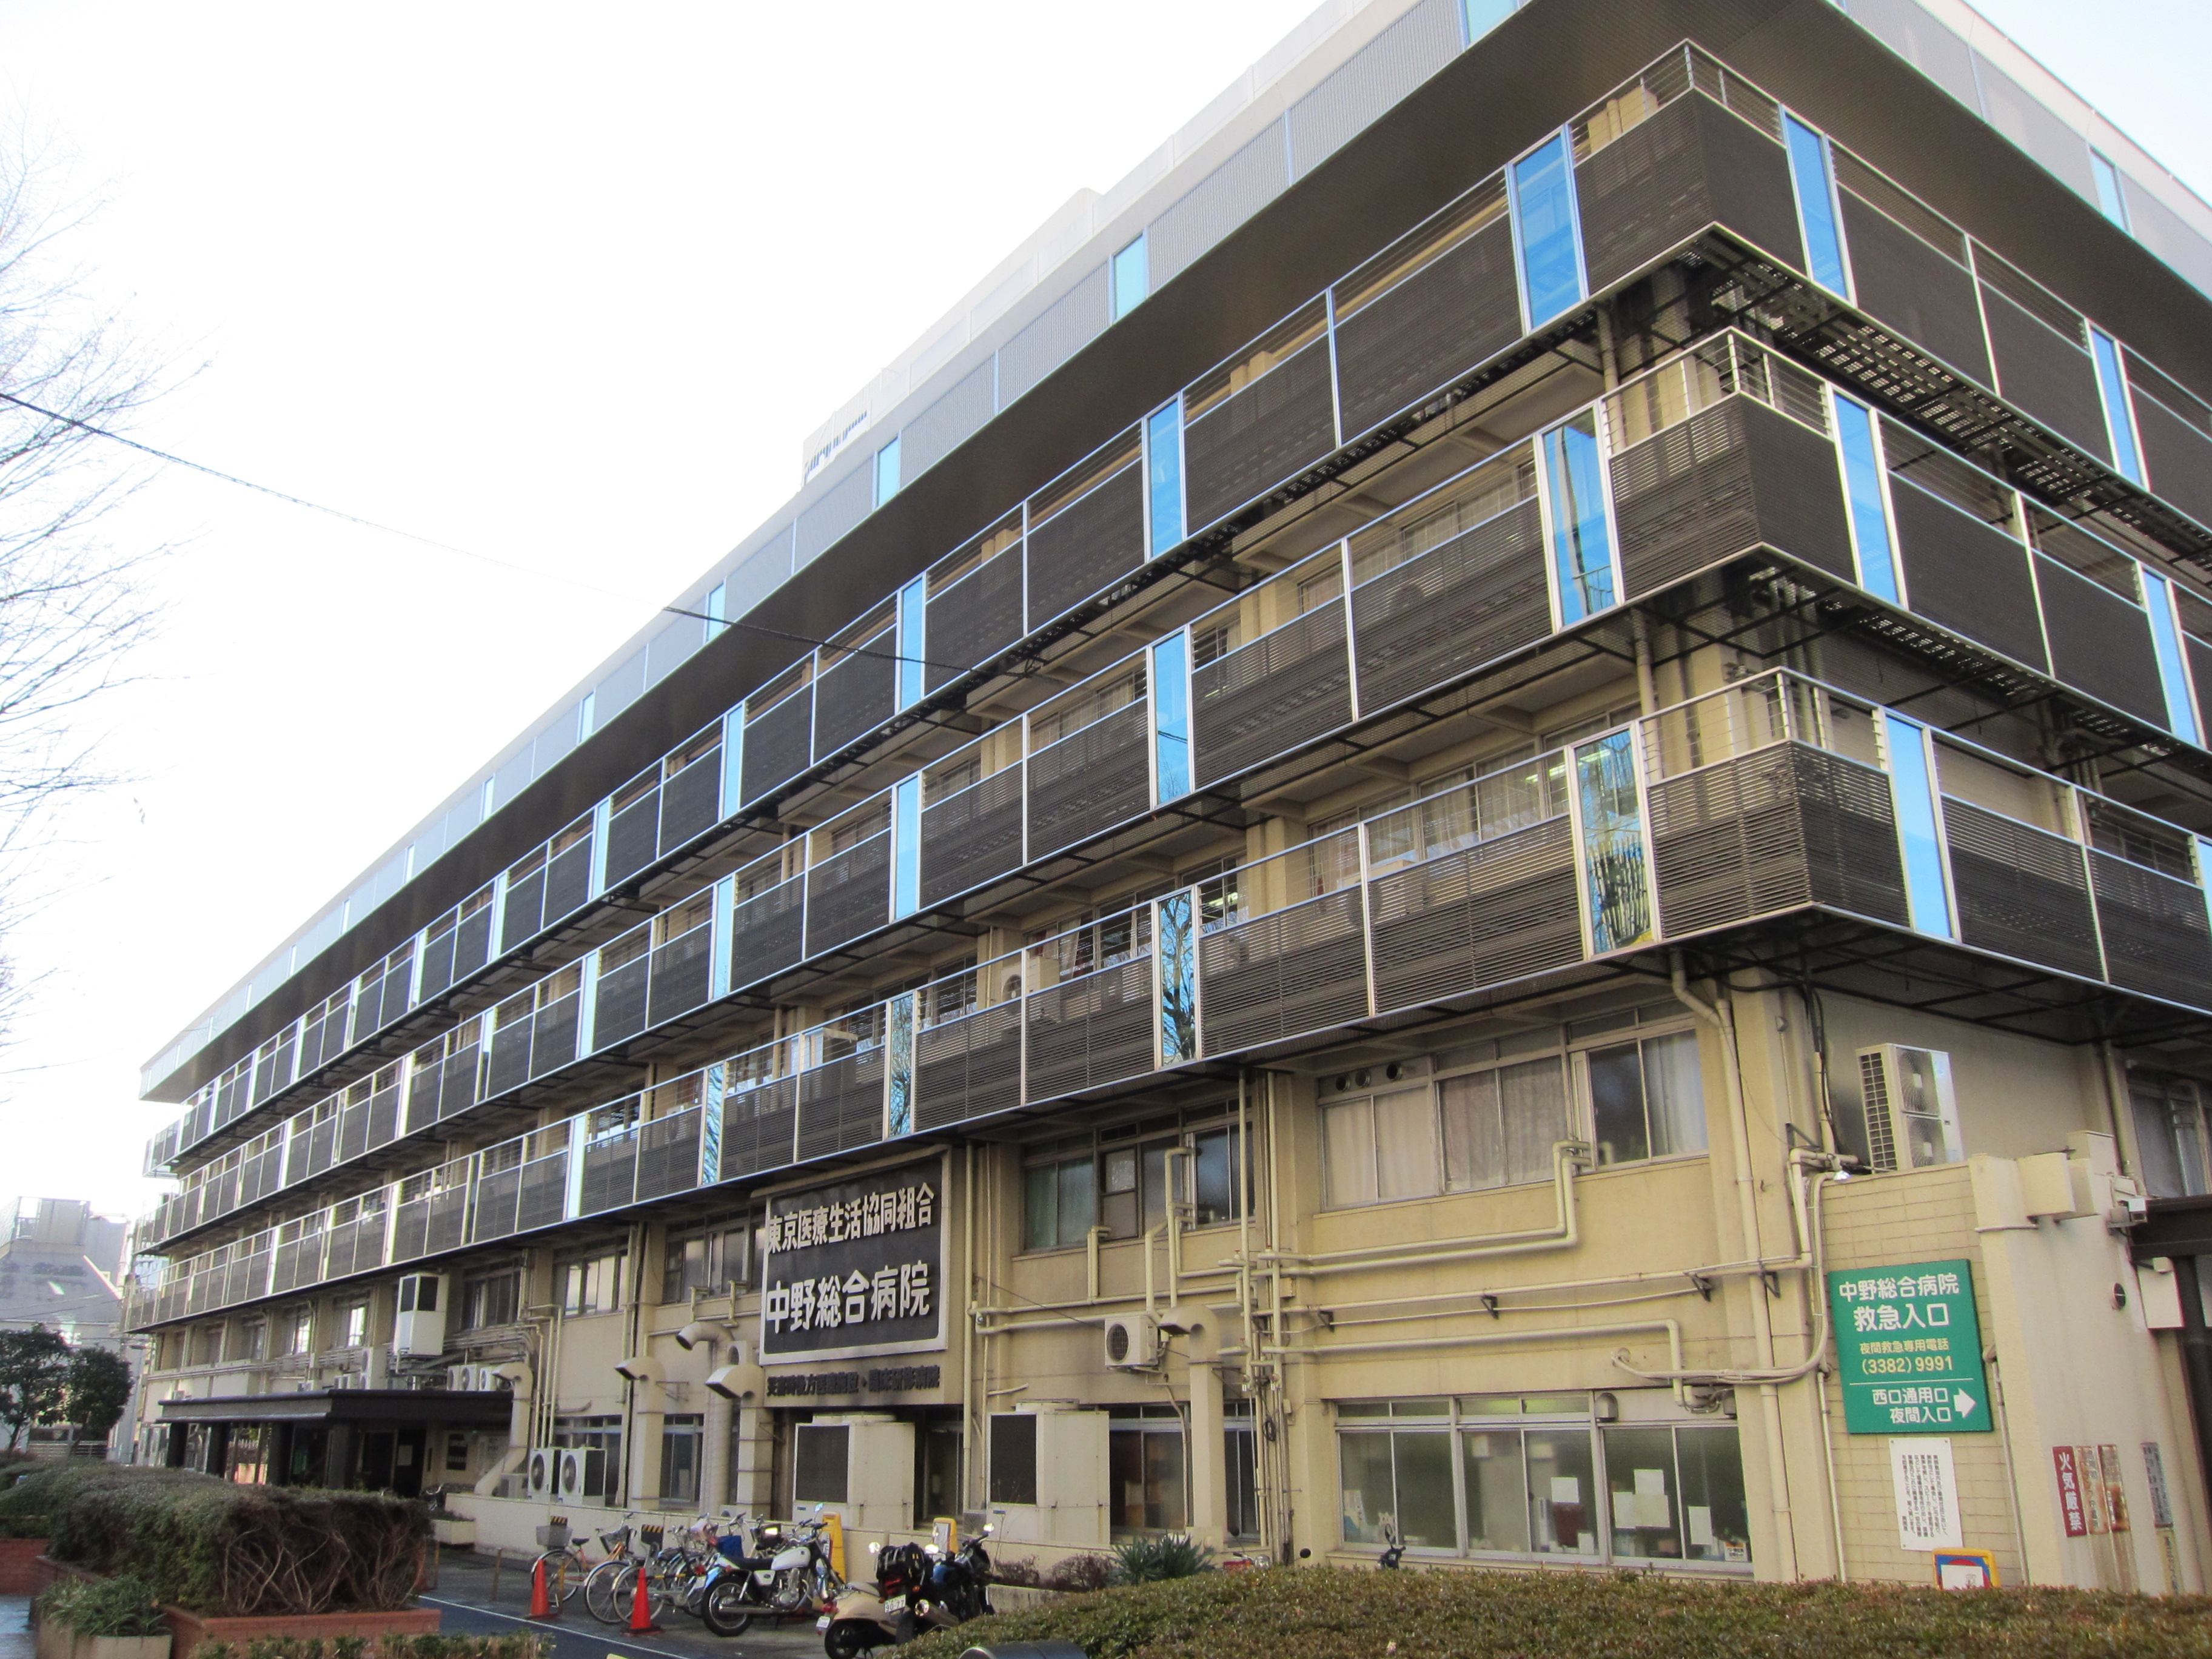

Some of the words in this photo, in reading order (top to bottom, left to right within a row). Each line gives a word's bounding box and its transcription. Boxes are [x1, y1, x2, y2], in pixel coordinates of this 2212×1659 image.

[768, 1182, 934, 1253] 東京医療生活協同組合
[766, 1260, 930, 1334] 中野総合病院
[1839, 1273, 1959, 1302] 中野総合病院
[1853, 1303, 1949, 1332] 救急入口
[1860, 1338, 1949, 1355] 夜間救急専用電話
[1872, 1387, 1949, 1405] 西口通用口
[1889, 1407, 1952, 1424] 夜間入口
[2059, 1452, 2082, 1531] 火気厳禁
